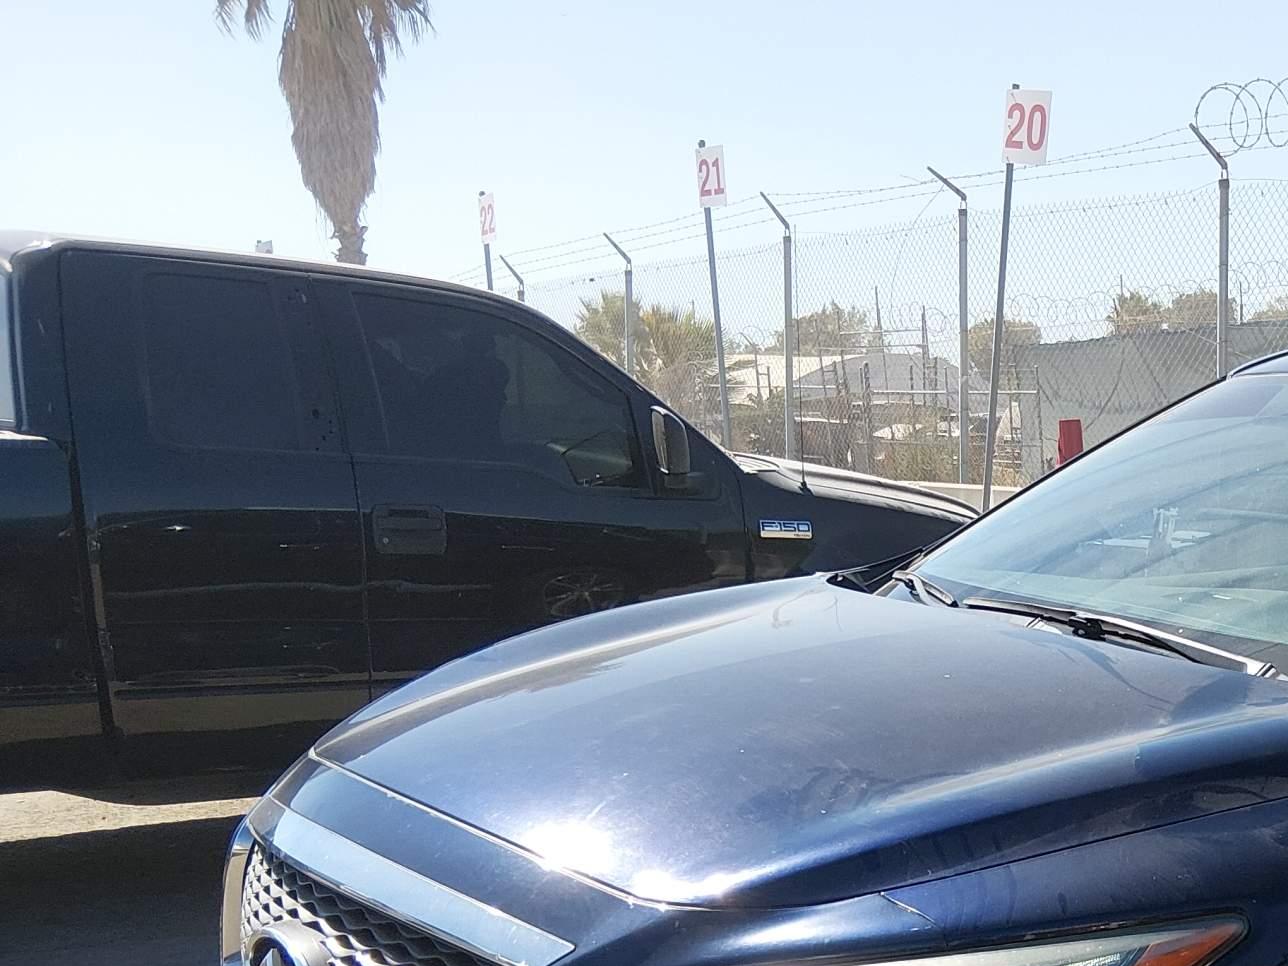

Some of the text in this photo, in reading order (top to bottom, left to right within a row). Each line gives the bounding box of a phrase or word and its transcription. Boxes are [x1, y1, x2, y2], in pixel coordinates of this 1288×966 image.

[1005, 102, 1047, 151] 20
[698, 157, 725, 197] 21
[480, 203, 495, 236] 22
